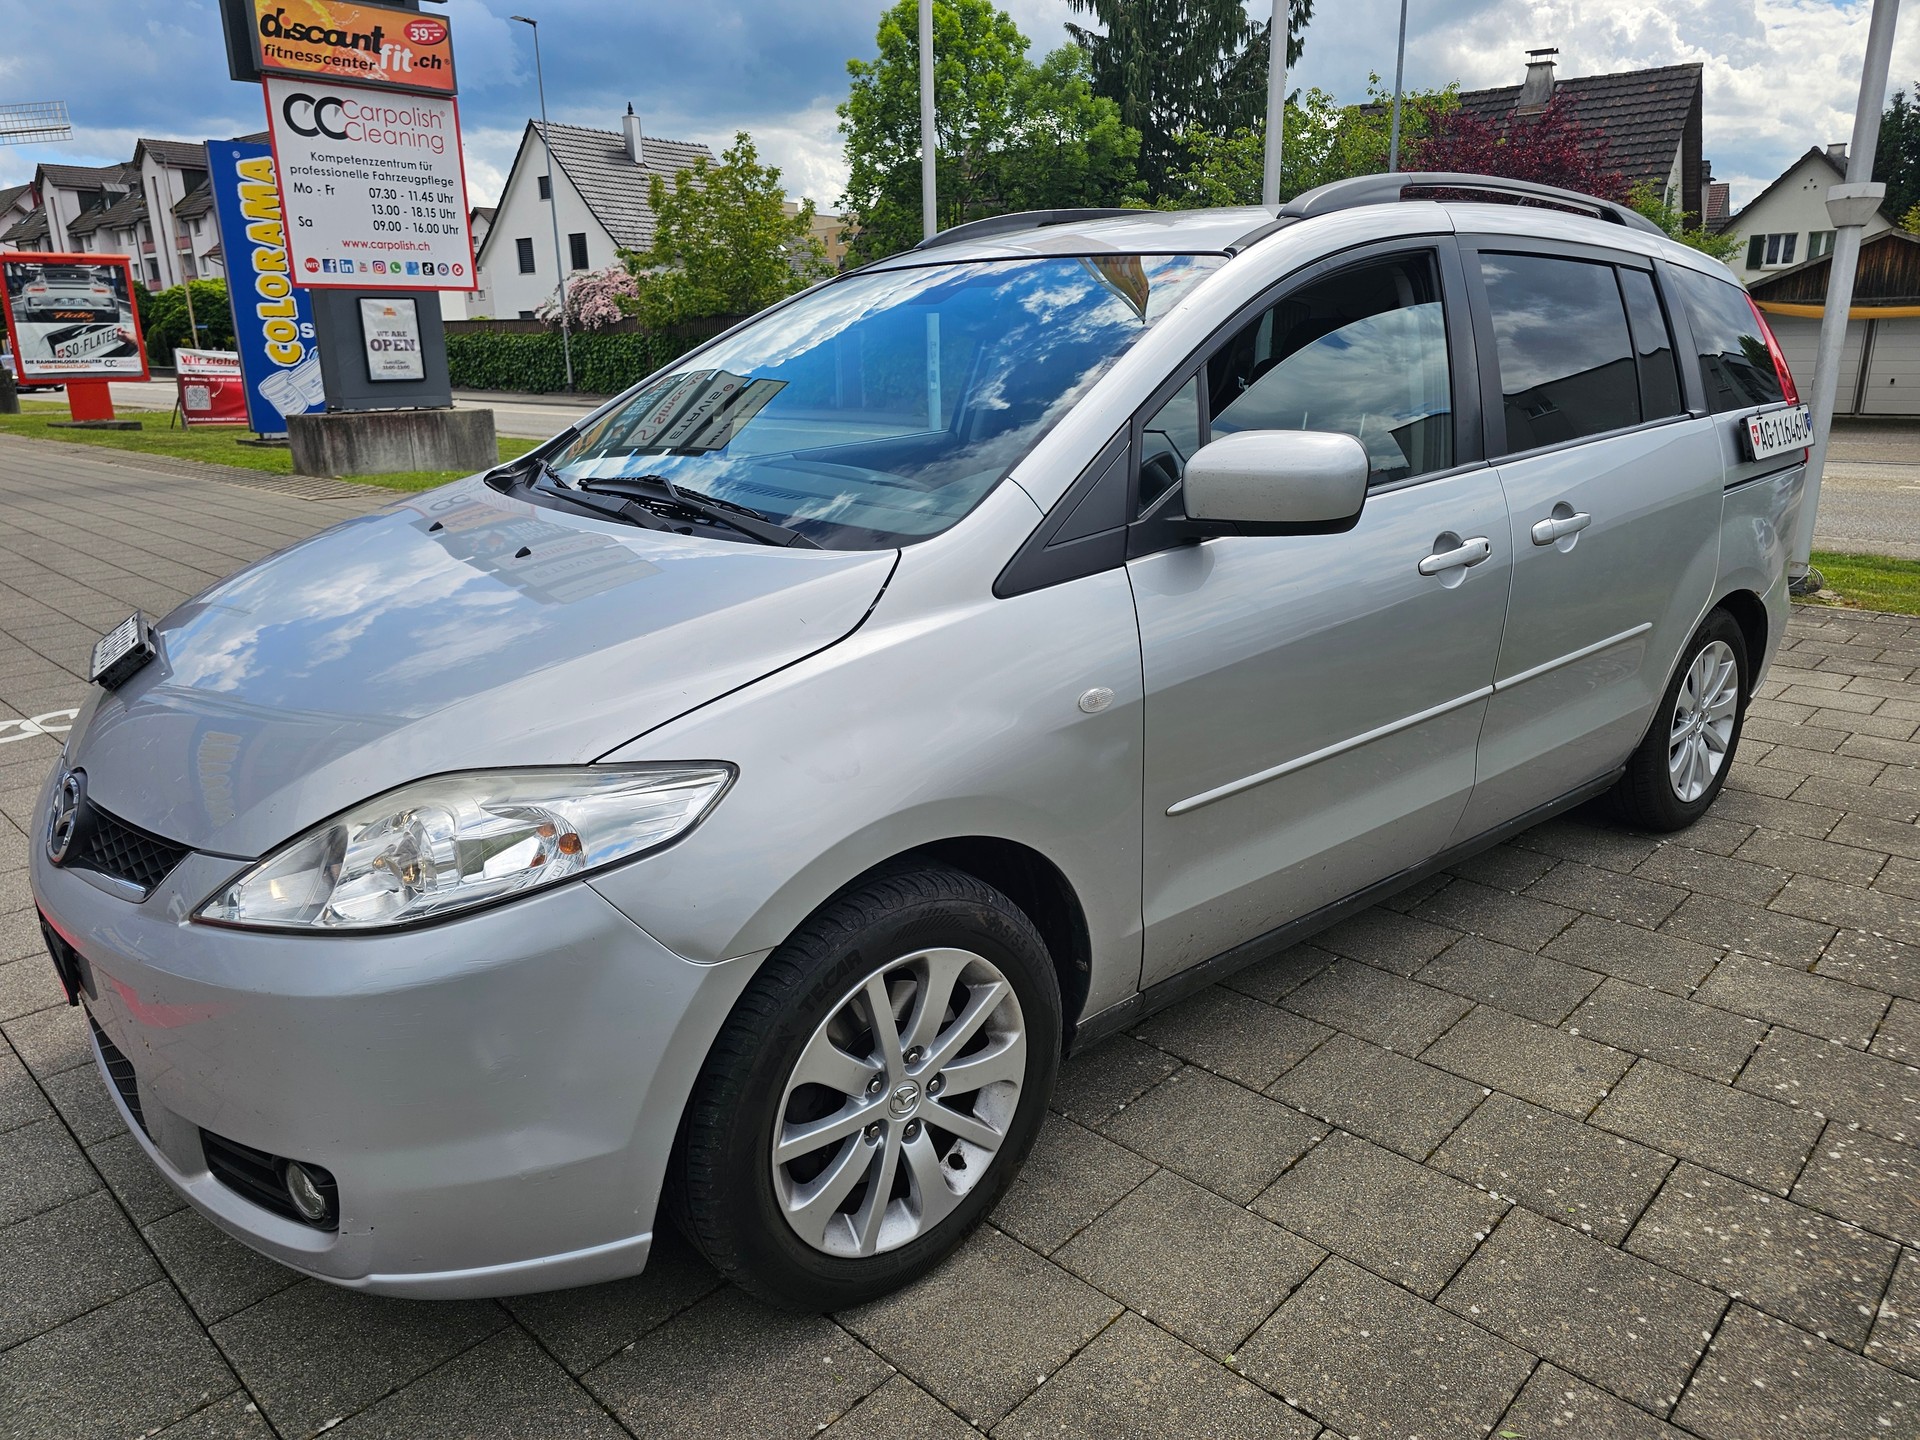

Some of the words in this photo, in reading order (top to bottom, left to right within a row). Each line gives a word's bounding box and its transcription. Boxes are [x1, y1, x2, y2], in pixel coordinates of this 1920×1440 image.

[260, 8, 385, 54] discount
[264, 44, 376, 71] fitnesscenter
[341, 99, 442, 129] Carpolish
[344, 121, 445, 154] Cleaning
[310, 151, 417, 170] Kompetenzzentrum
[419, 161, 433, 172] für
[290, 165, 370, 181] professionelle
[372, 171, 454, 188] Fahrzeugpflege
[293, 182, 313, 194] Mo
[325, 184, 335, 196] Fr
[368, 187, 397, 200] 07.30
[408, 190, 434, 203] 11.45
[437, 192, 454, 204] Uhr
[371, 204, 400, 216] 13.00
[411, 206, 436, 219] 18.15
[439, 209, 456, 220] Uhr
[298, 215, 313, 228] Sa
[373, 220, 402, 233] 09.00
[413, 222, 440, 235] 16.00
[442, 224, 459, 236] Uhr
[342, 240, 430, 252] www.carpolish.ch
[237, 157, 304, 368] COLORAMA
[370, 339, 415, 352] OPEN
[181, 355, 202, 364] Wir
[206, 358, 240, 366] ziehe
